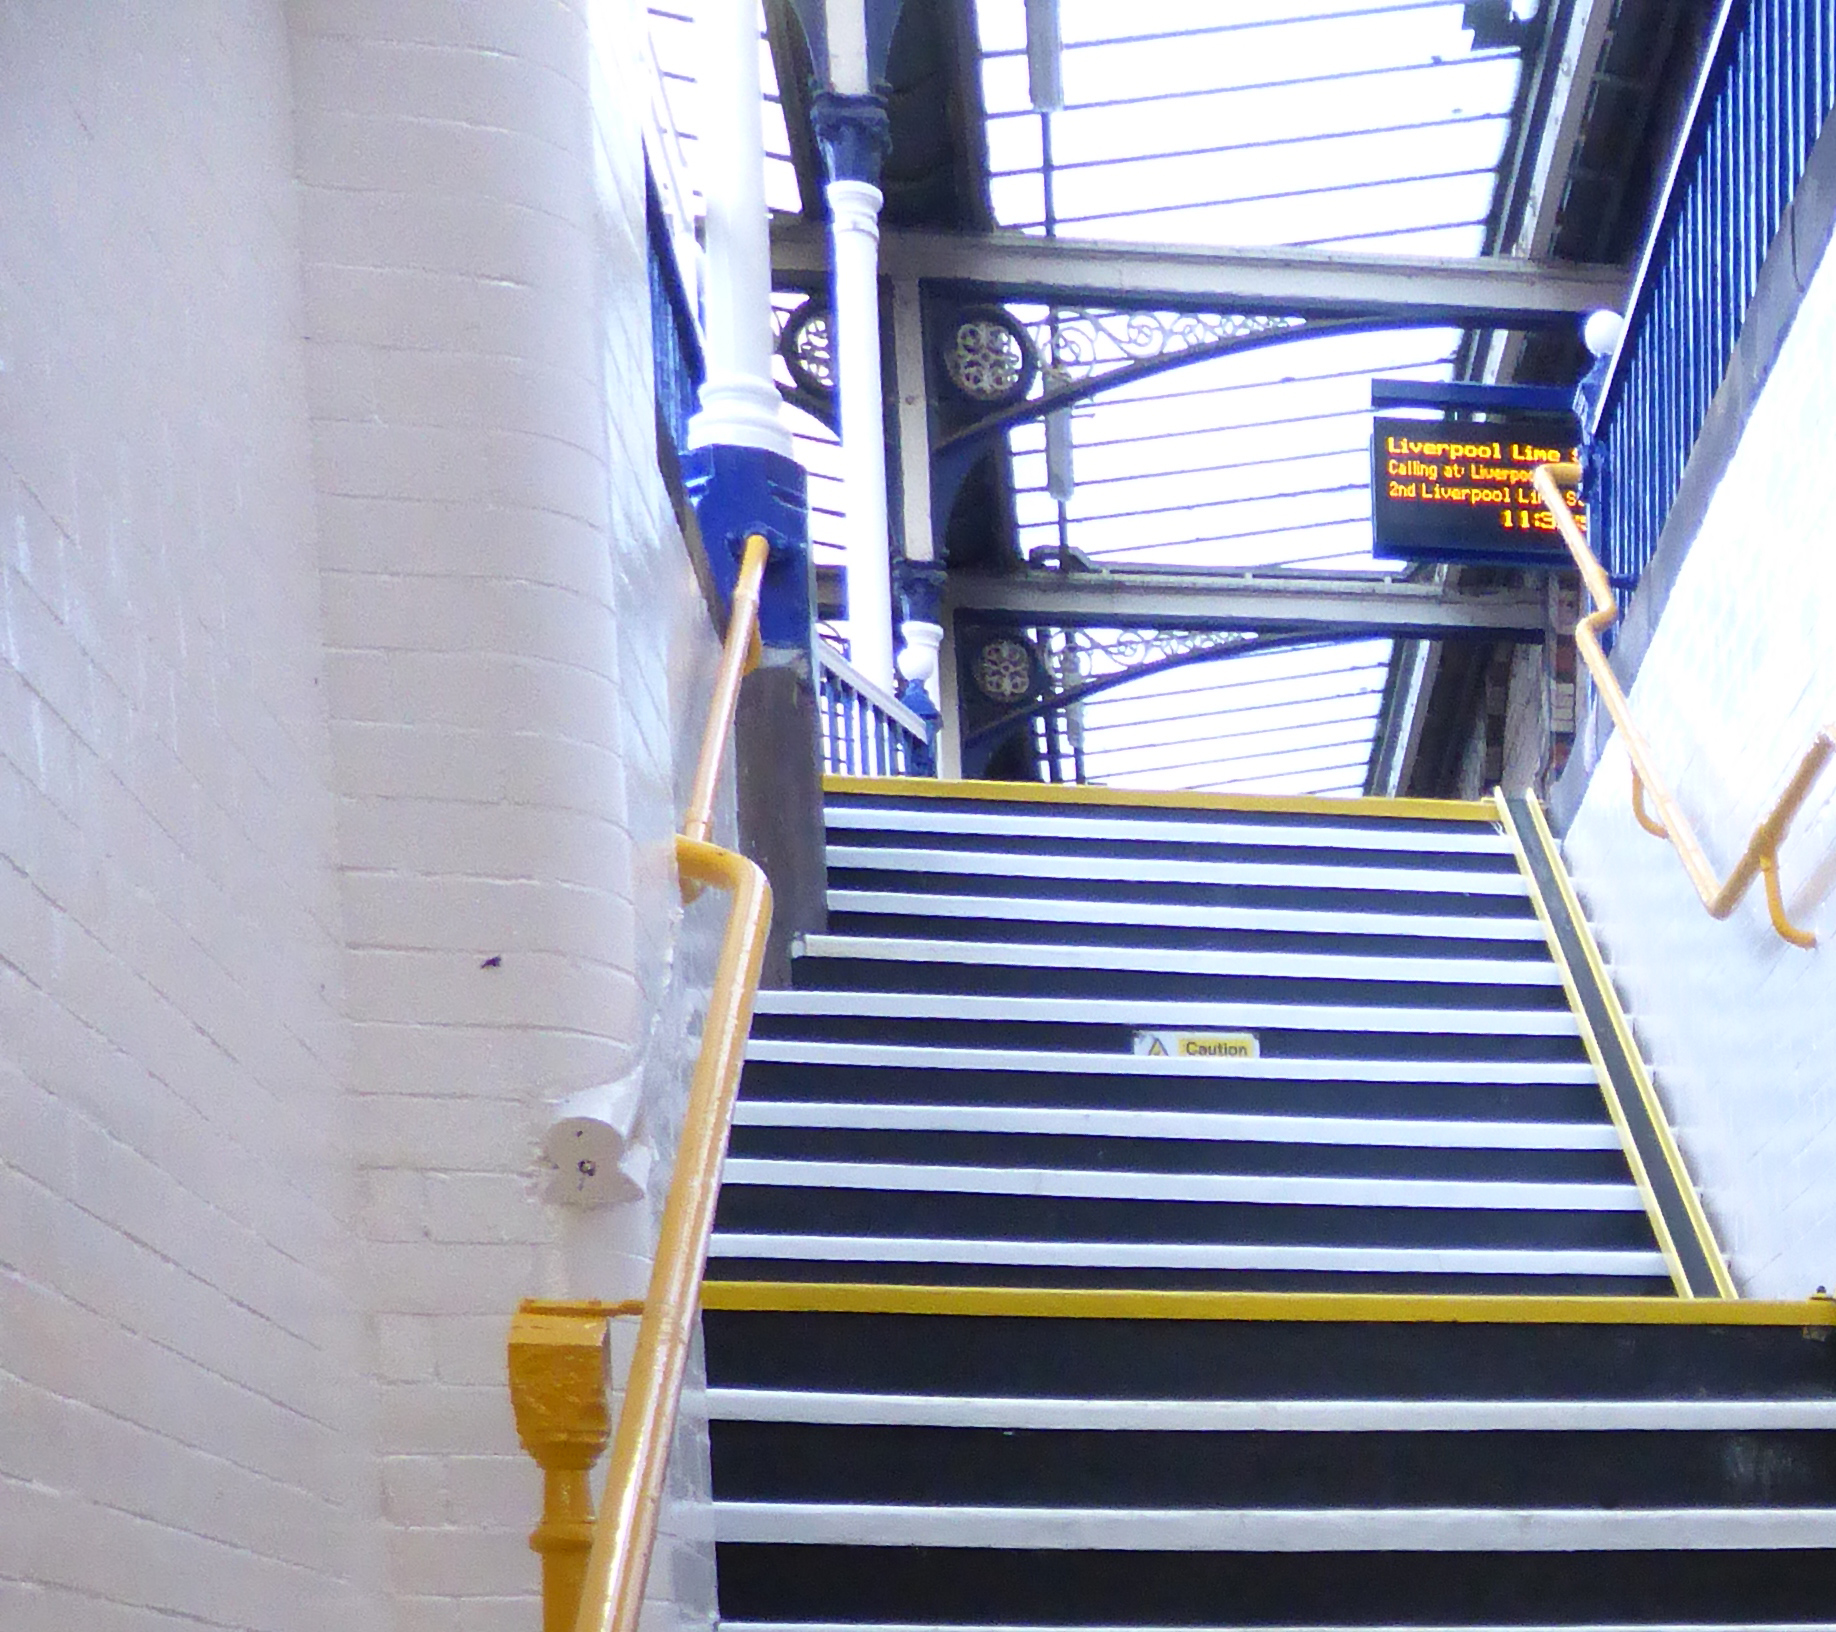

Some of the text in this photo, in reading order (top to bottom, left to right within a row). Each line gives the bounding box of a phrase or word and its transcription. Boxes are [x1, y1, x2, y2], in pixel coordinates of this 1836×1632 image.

[1387, 437, 1501, 460] Liverpool
[1511, 444, 1561, 462] Lime
[1388, 459, 1438, 480] Calling
[1389, 480, 1416, 498] 2nd
[1421, 482, 1511, 505] Liverpool
[1186, 1041, 1248, 1056] Caution
